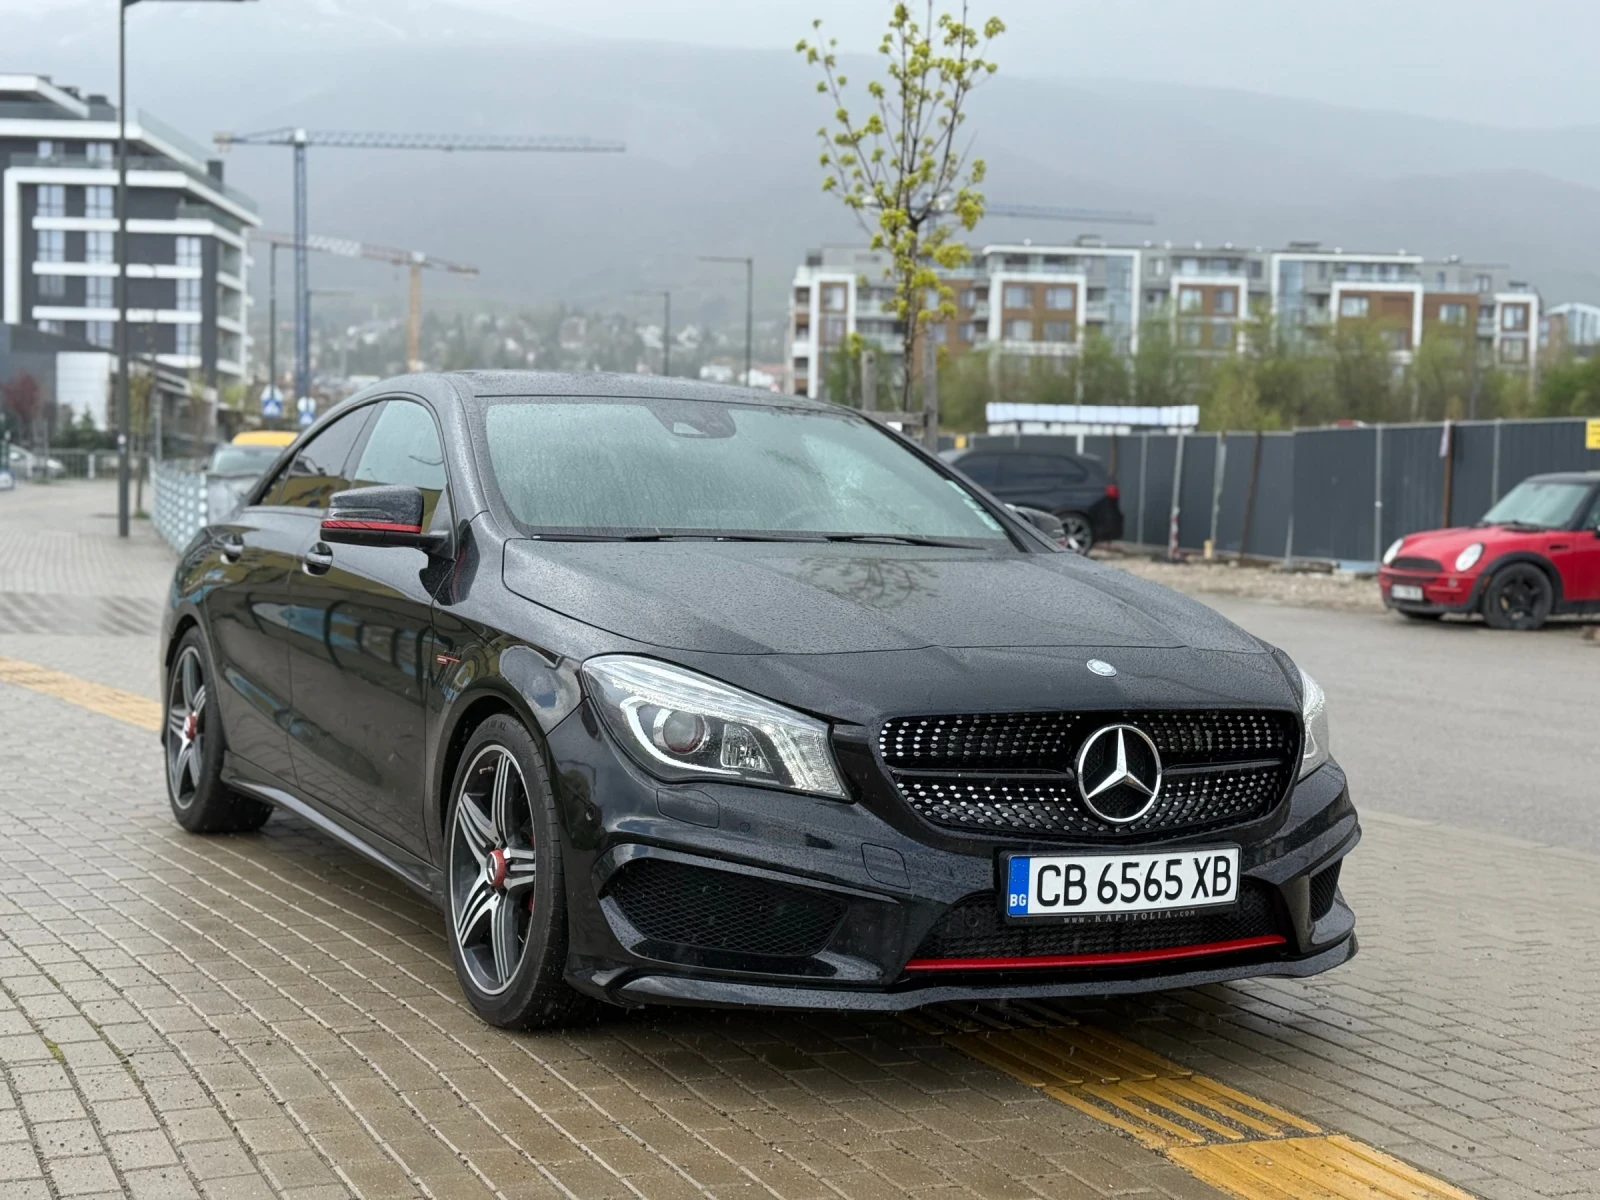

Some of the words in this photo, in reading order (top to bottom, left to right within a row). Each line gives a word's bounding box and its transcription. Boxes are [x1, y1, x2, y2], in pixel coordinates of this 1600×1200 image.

[1036, 863, 1087, 907] CB
[1097, 859, 1183, 905] 6565
[1190, 855, 1232, 899] XB
[1010, 894, 1027, 907] BG
